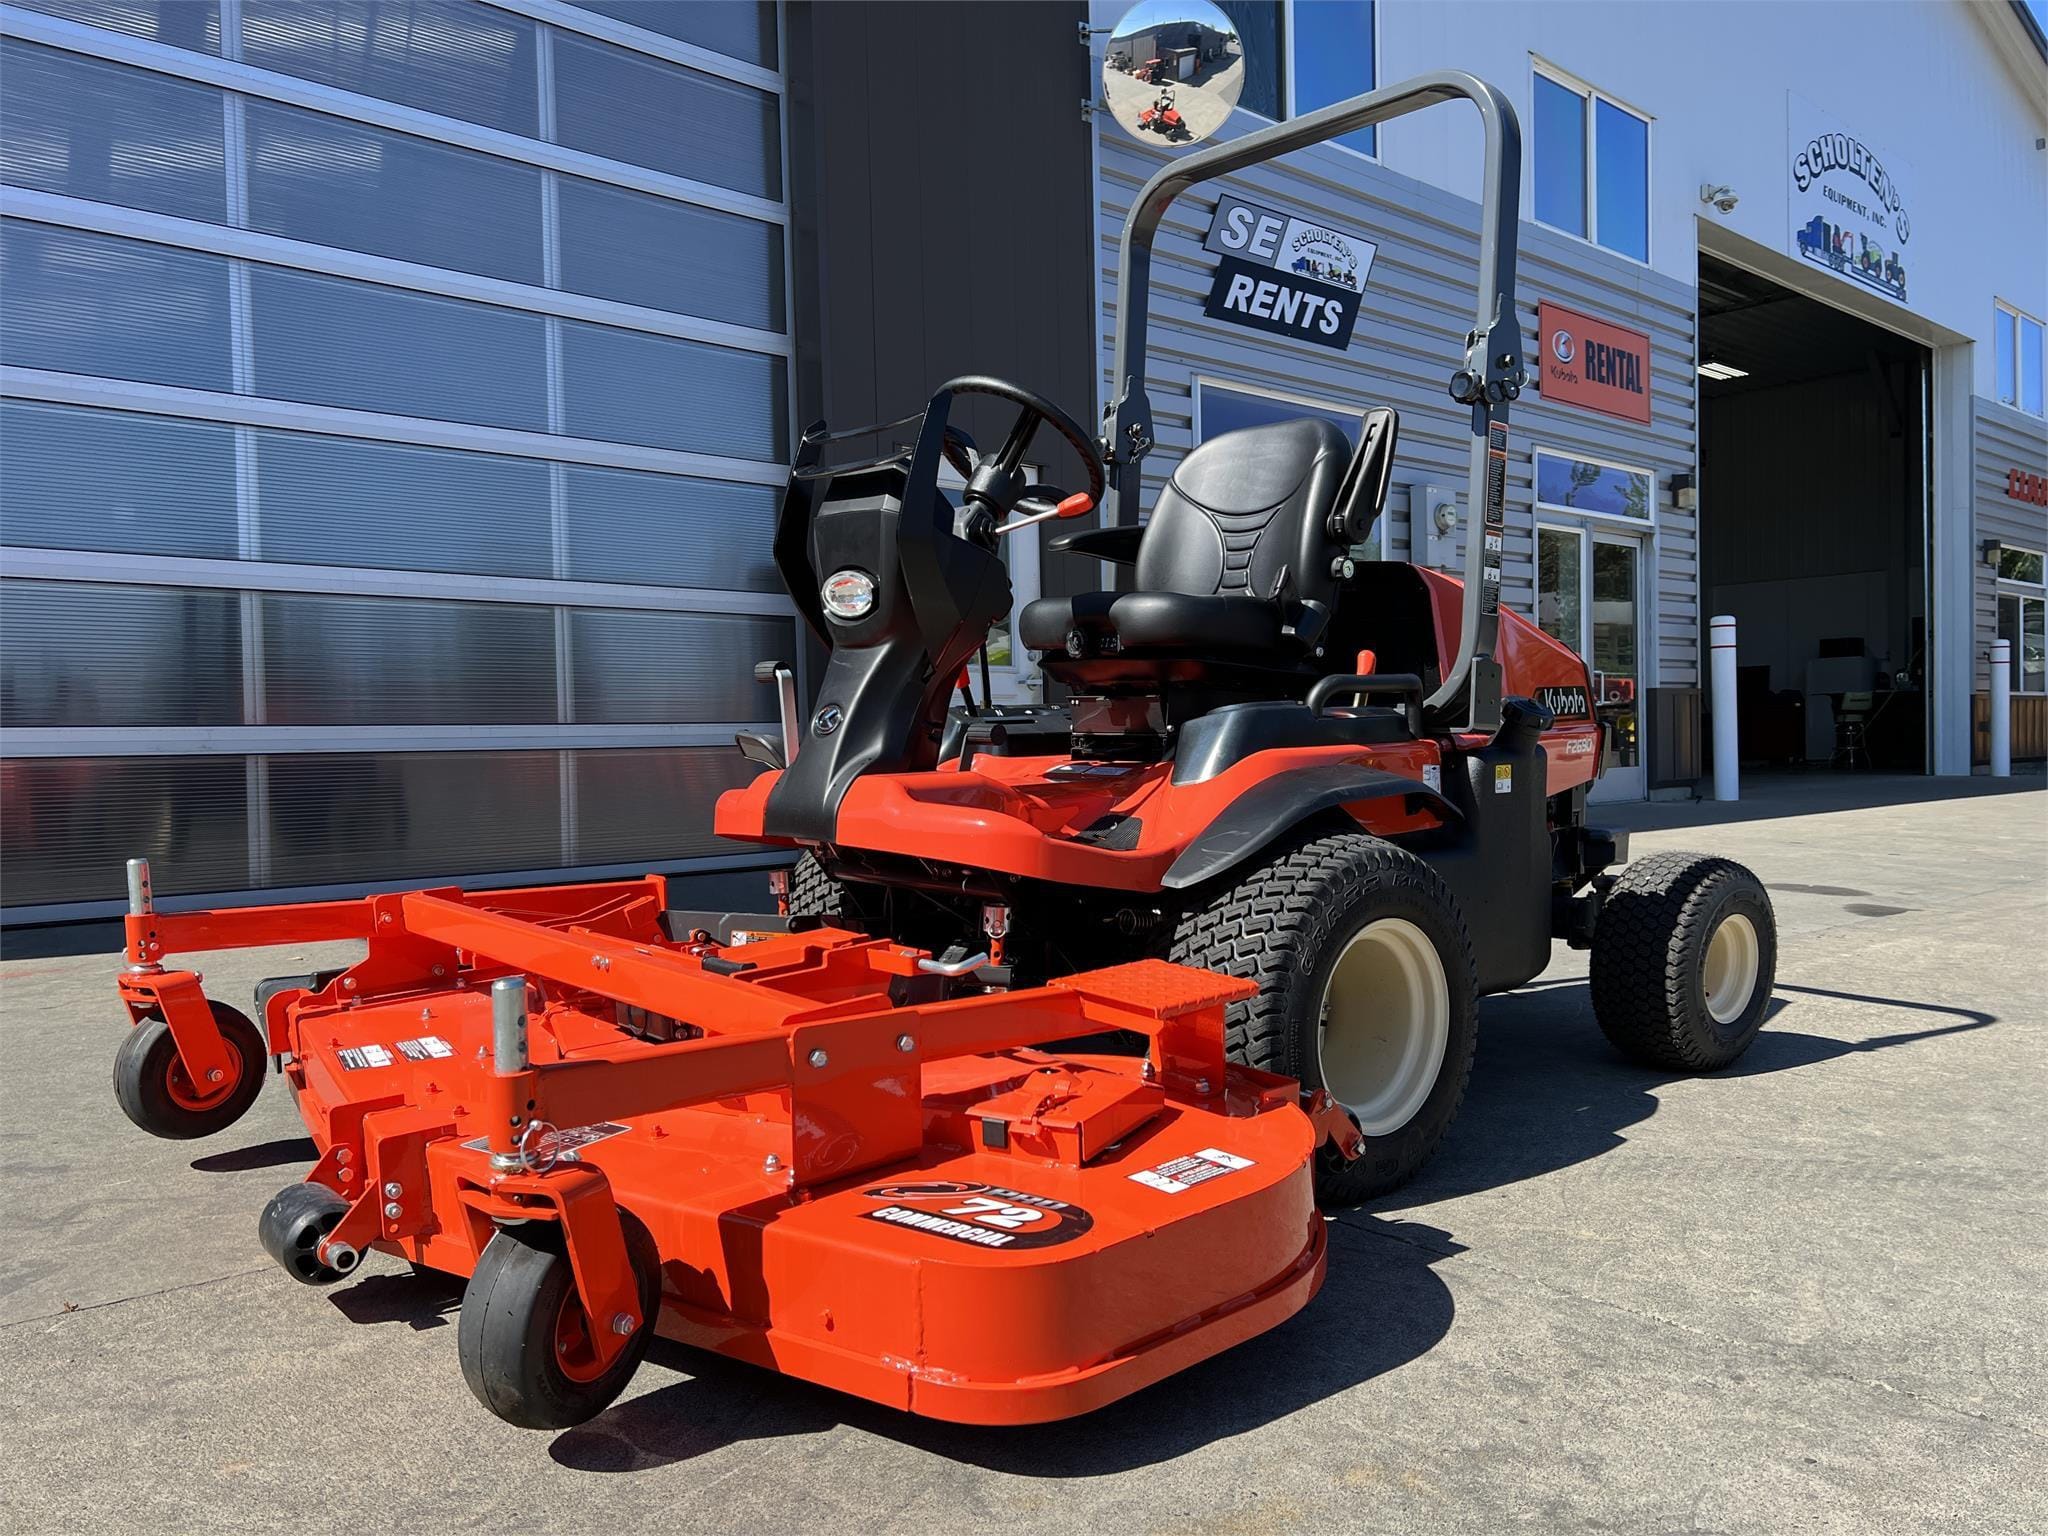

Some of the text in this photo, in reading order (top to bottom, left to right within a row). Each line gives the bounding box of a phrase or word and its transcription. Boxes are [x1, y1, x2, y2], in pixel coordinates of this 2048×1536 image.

[1793, 132, 1910, 245] SCHOLTEN'S
[1220, 206, 1284, 259] SE
[1872, 211, 1887, 229] INC.
[1291, 228, 1358, 270] SCHOLTEN'S
[1223, 273, 1343, 335] RENTS
[1551, 365, 1578, 385] Kubota
[1585, 339, 1643, 394] RENTAL
[1544, 688, 1586, 715] Kubota
[871, 1206, 1016, 1247] COMMERCIAL
[940, 1197, 1043, 1228] 72
